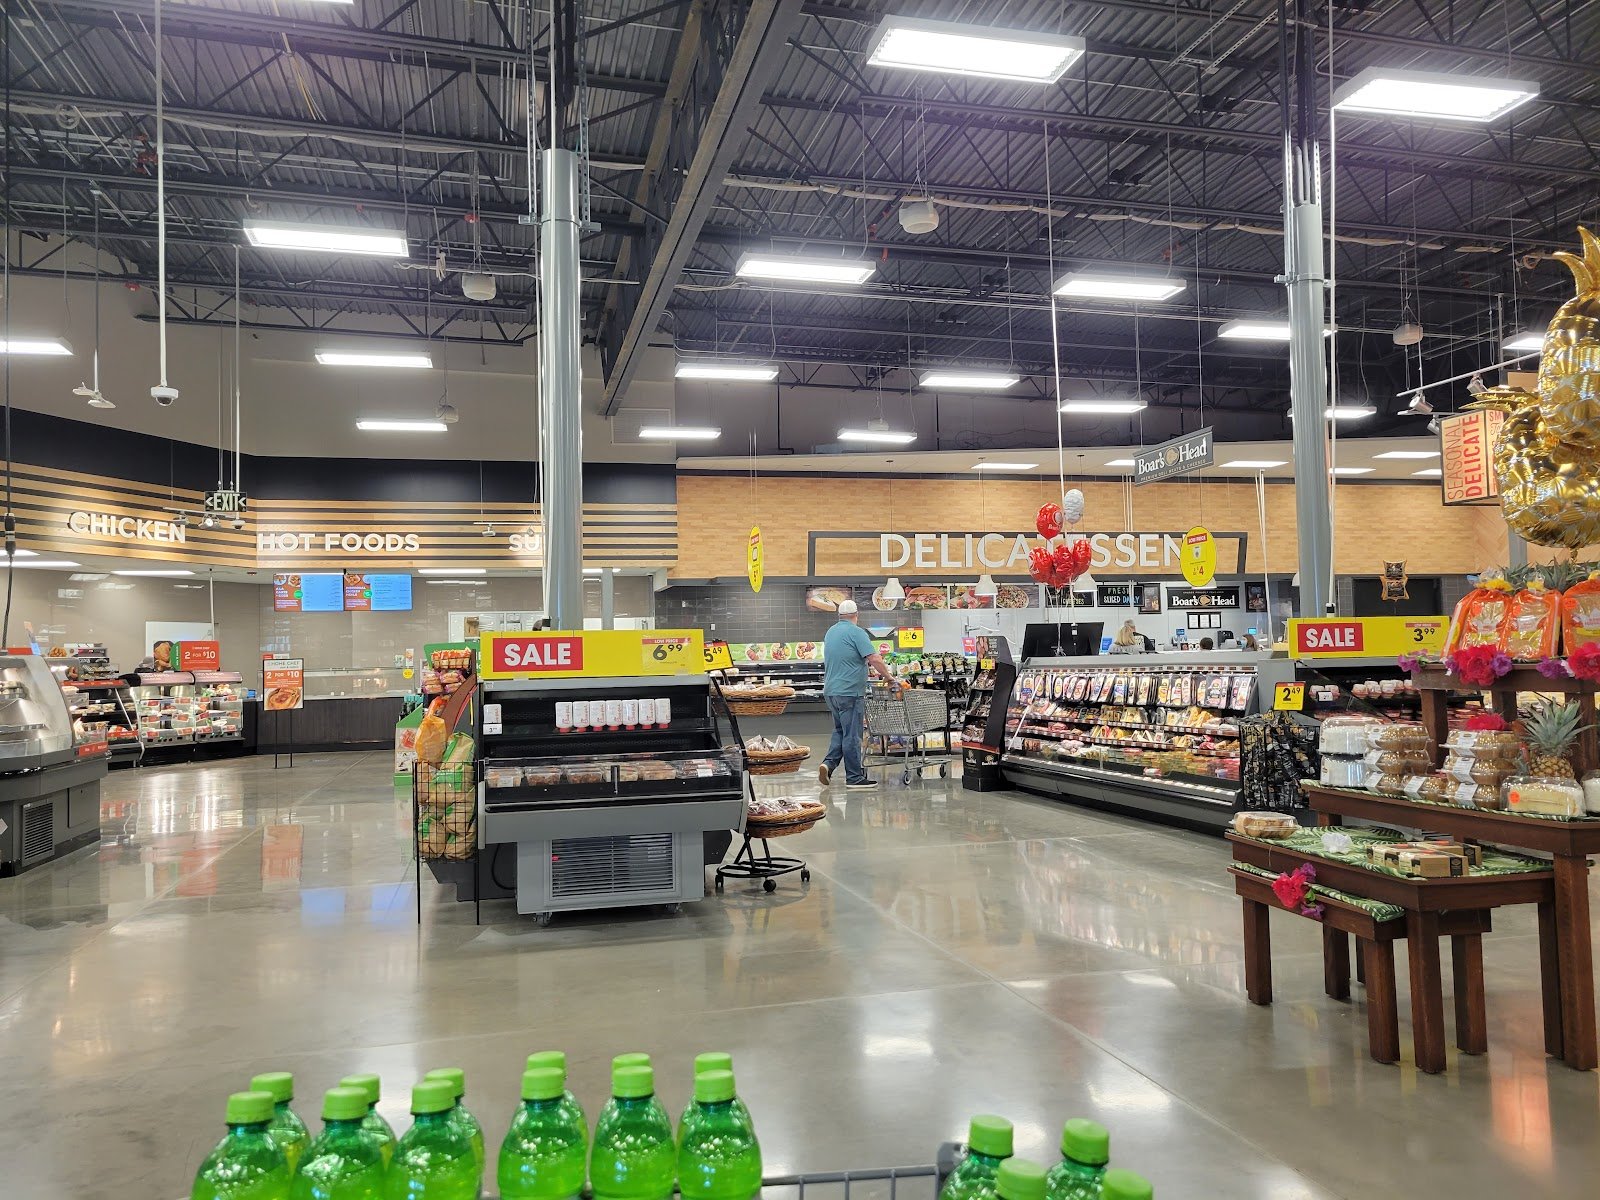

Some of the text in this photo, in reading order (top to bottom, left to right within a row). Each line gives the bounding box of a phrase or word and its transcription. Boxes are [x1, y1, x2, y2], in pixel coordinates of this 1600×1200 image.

[1138, 436, 1208, 475] Boar's Head
[1444, 418, 1464, 500] SEASONAL
[1462, 414, 1483, 498] DELICATE
[213, 492, 240, 511] EXIT
[68, 511, 186, 544] CHICKEN
[257, 532, 420, 553] HOT FOODS
[509, 533, 541, 552] SU
[1122, 595, 1140, 604] DALY
[1172, 594, 1235, 606] Boar's Head
[1305, 627, 1356, 648] SALE
[184, 651, 191, 660] 2
[202, 650, 216, 659] $10
[504, 642, 572, 667] SALE
[266, 671, 272, 680] 2
[286, 670, 300, 679] $10
